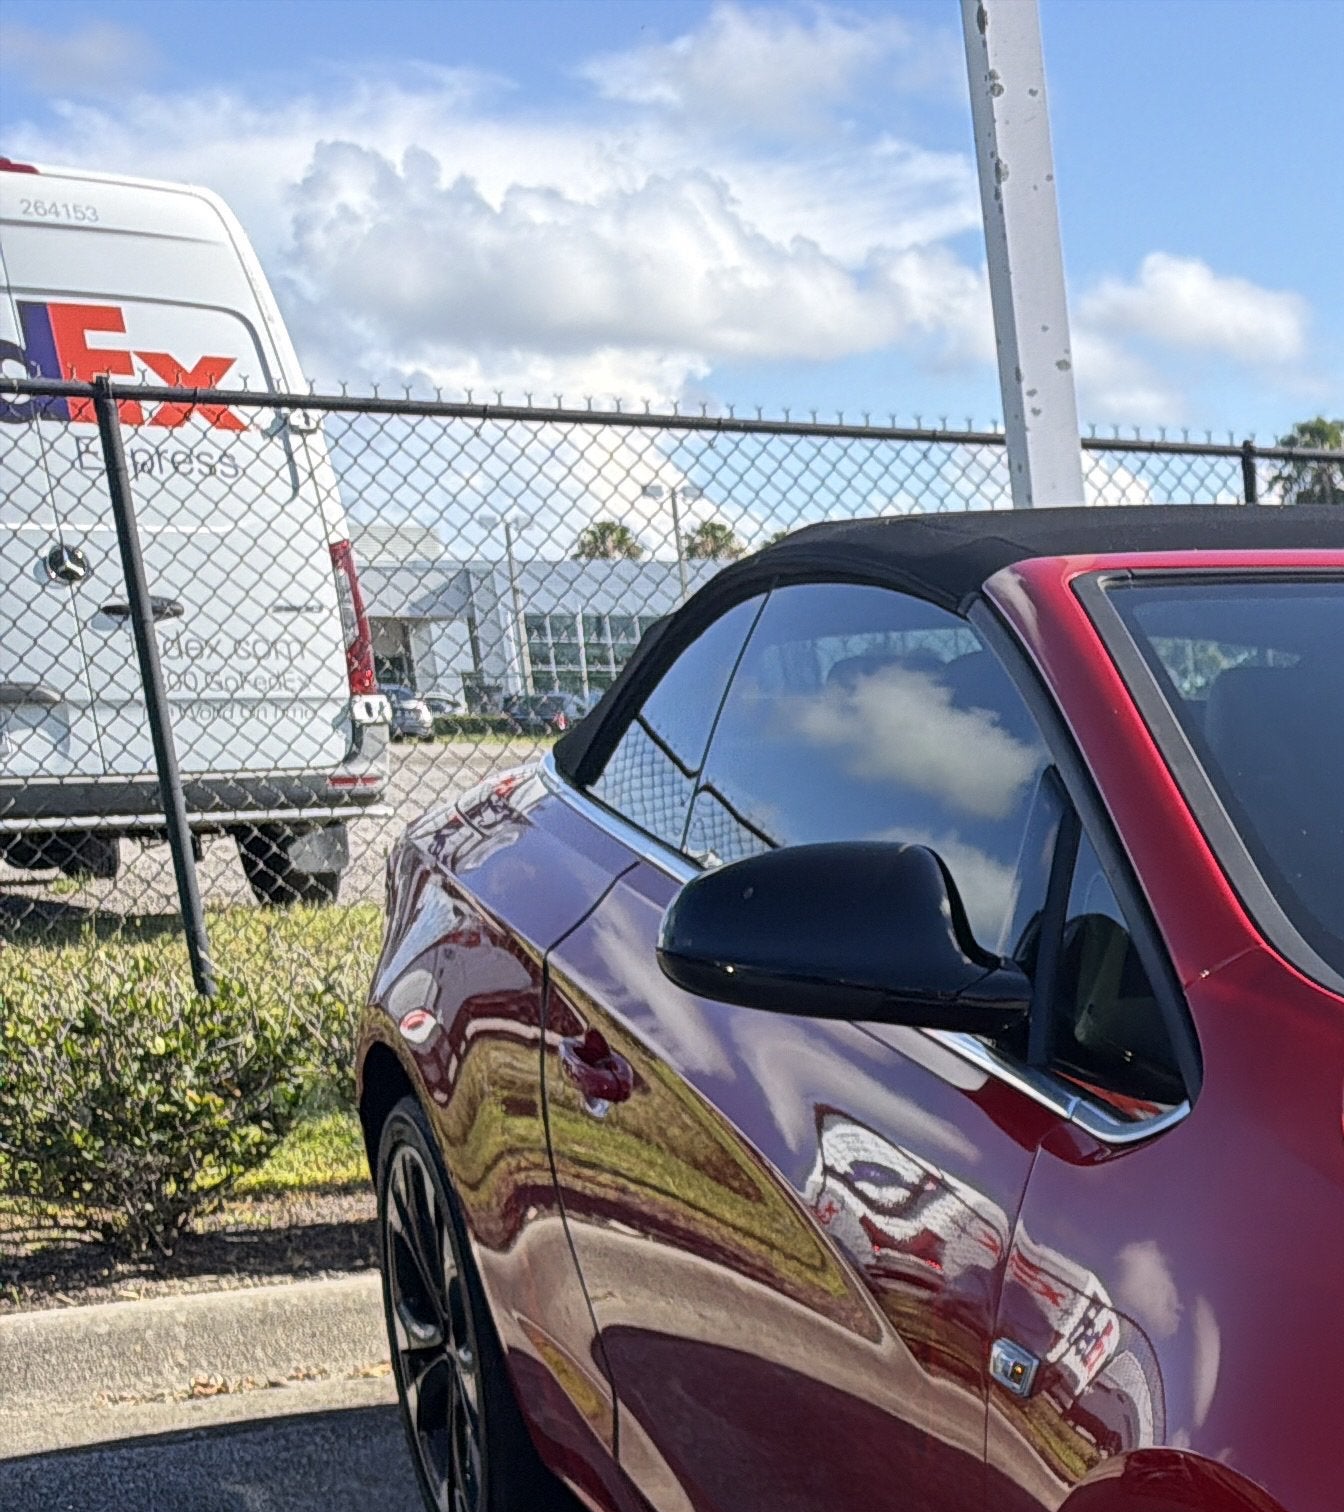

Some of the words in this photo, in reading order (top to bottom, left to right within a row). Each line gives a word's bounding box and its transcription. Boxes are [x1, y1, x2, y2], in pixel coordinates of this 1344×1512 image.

[20, 199, 99, 223] 264153
[0, 299, 250, 432] dEx
[75, 436, 241, 482] Epress
